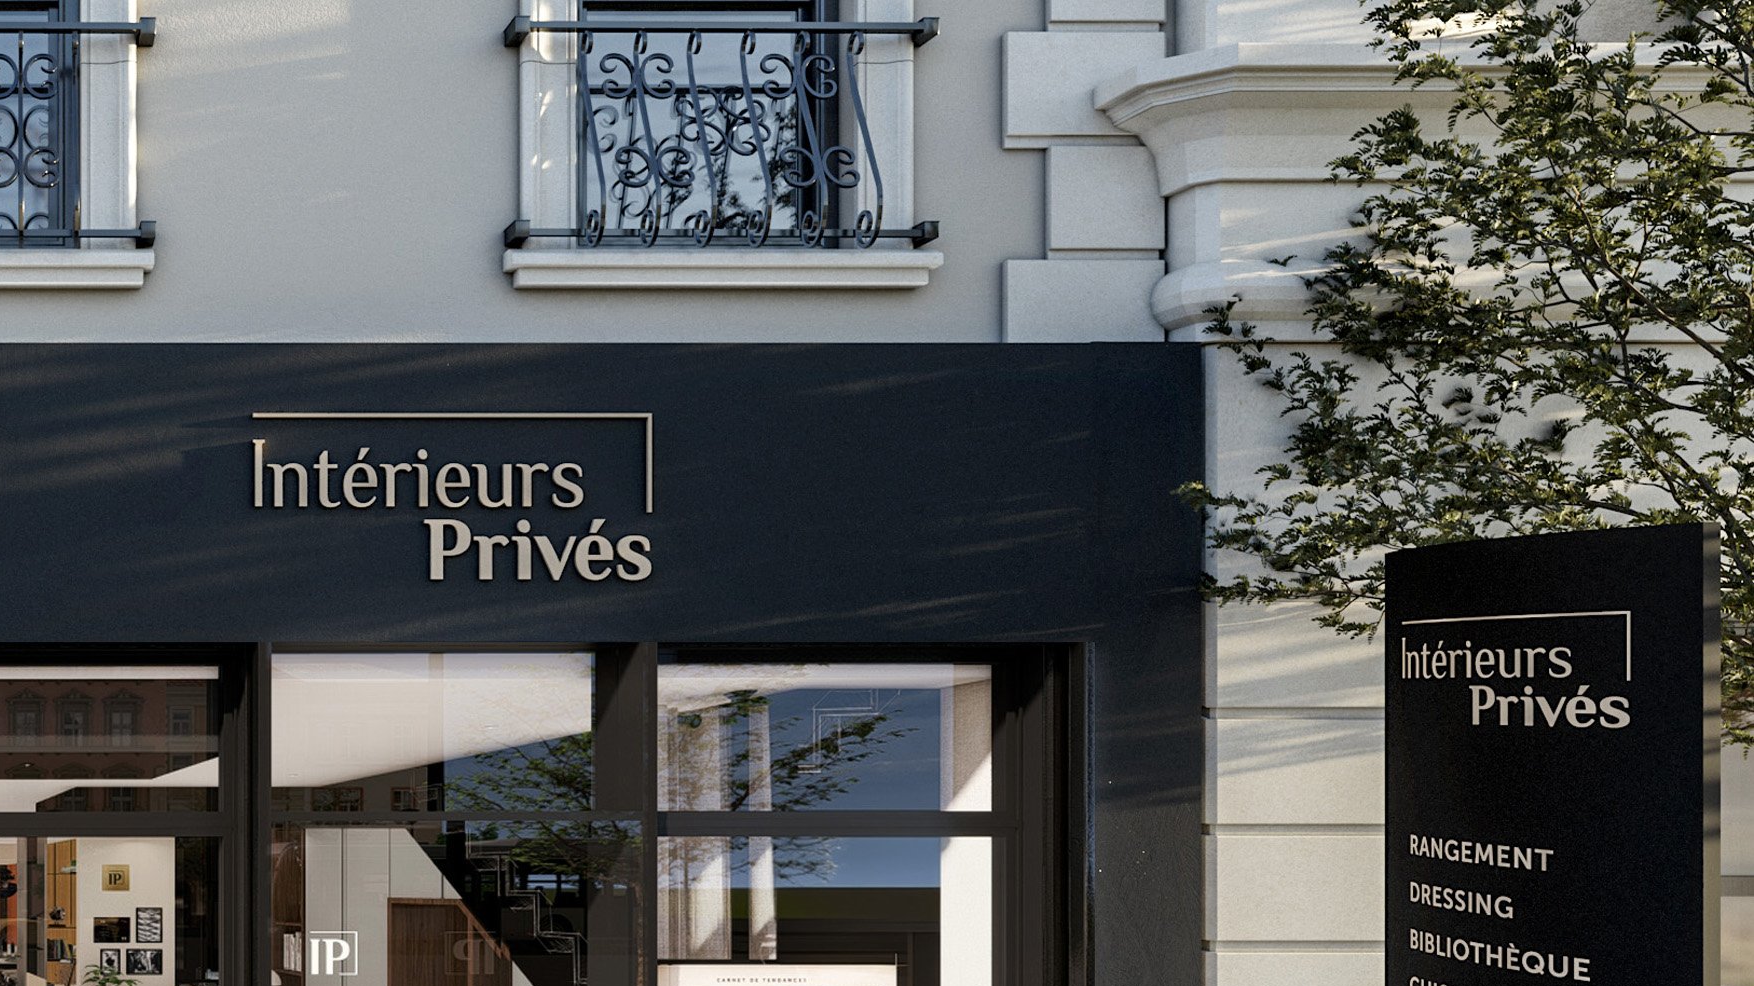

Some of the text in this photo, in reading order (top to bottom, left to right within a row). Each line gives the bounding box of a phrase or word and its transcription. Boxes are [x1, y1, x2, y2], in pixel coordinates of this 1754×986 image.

[252, 438, 584, 509] Intérieurs
[423, 518, 653, 582] Privés
[1401, 636, 1573, 680] Intérieurs
[1468, 684, 1632, 729] Privés
[1409, 834, 1554, 872] RANGEMENT
[1409, 881, 1514, 920] DRESSING
[310, 938, 351, 976] IP
[1409, 928, 1591, 983] BIBLIOTHÈQUE
